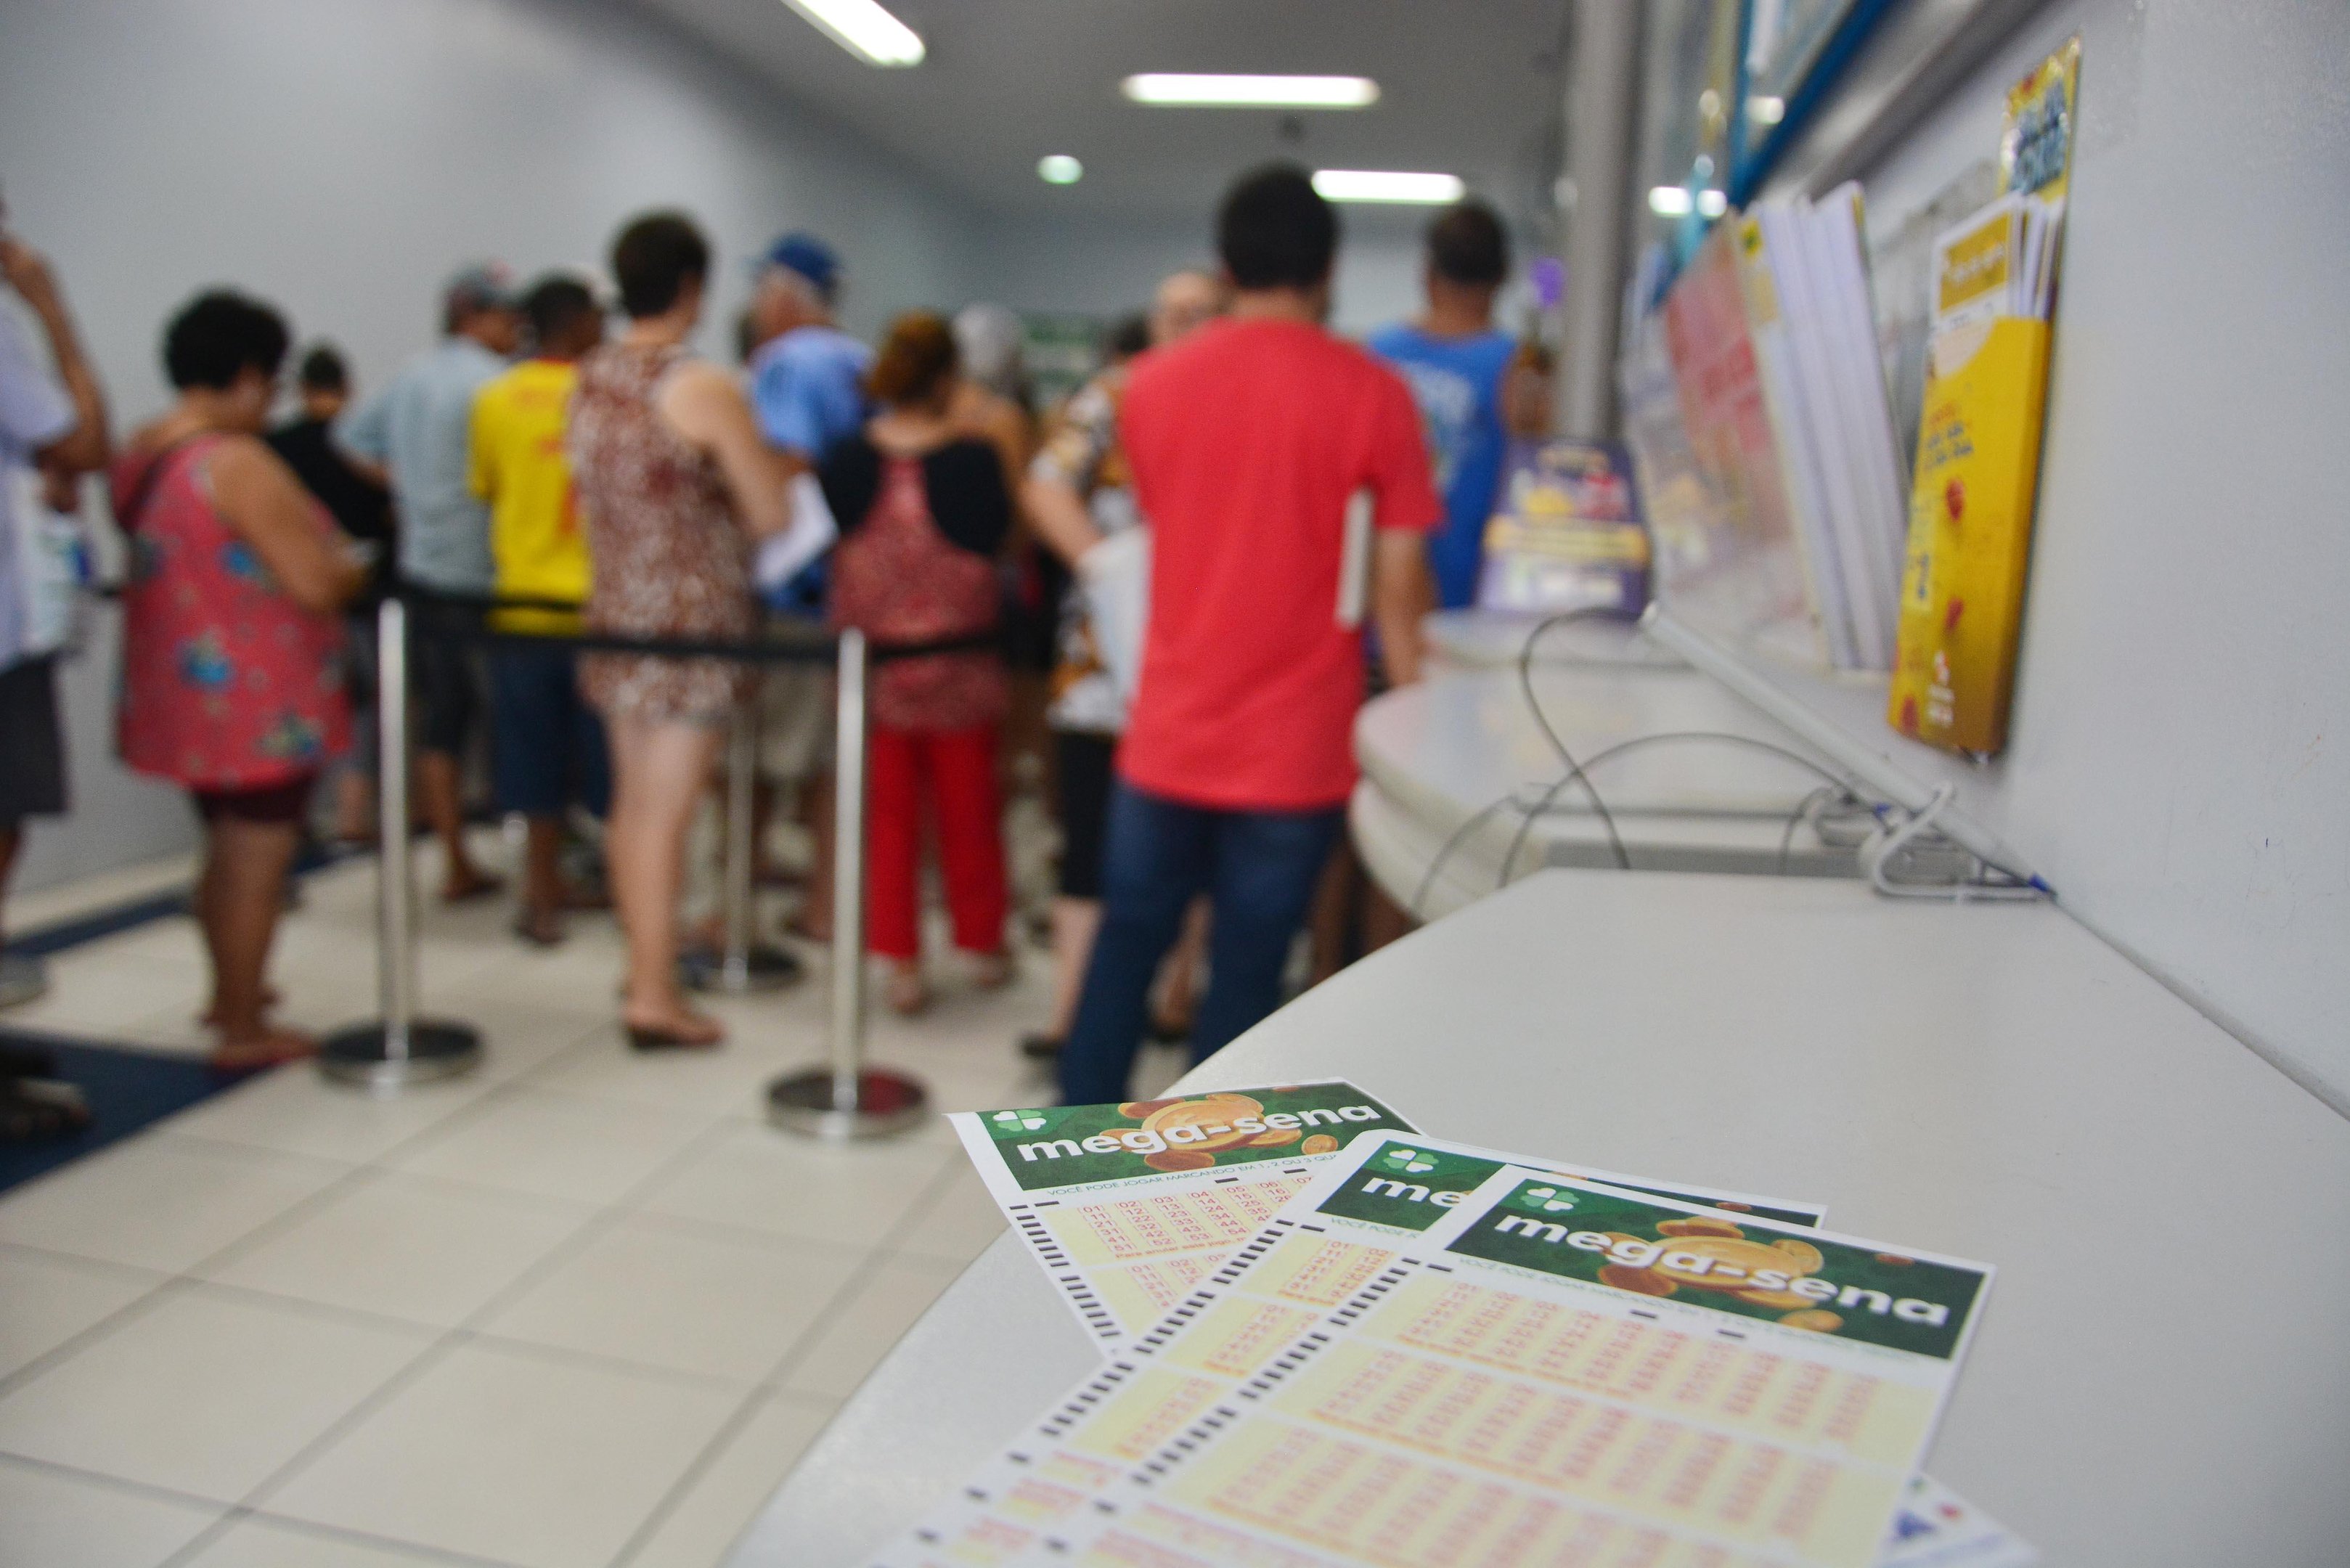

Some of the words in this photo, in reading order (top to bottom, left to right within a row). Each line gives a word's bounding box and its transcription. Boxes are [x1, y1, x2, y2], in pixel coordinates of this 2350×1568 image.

[1016, 1106, 1382, 1161] mega-sena
[1048, 1186, 1083, 1196] VOCÊ
[1085, 1182, 1120, 1191] PODE
[1124, 1177, 1163, 1186] JOGAR
[1166, 1167, 1236, 1181] MARCANDO
[1495, 1214, 1951, 1328] mega-sena
